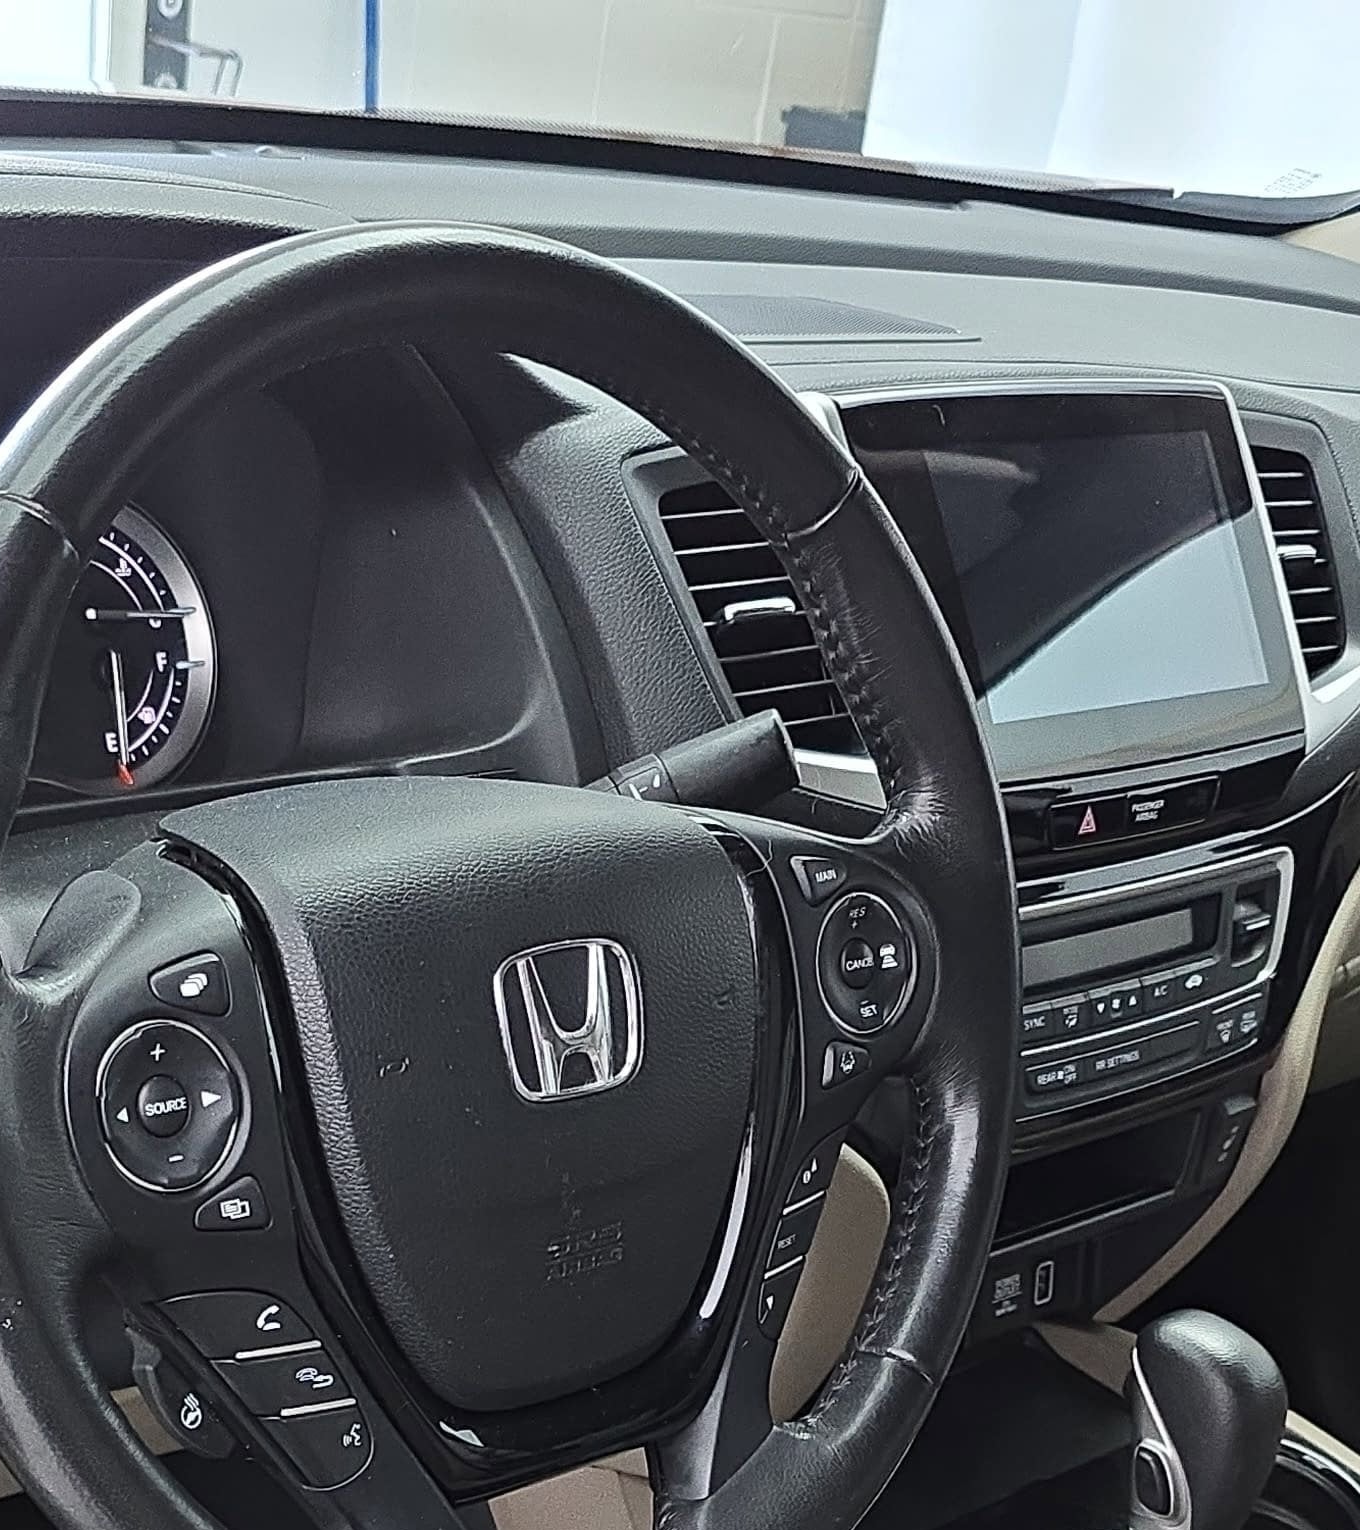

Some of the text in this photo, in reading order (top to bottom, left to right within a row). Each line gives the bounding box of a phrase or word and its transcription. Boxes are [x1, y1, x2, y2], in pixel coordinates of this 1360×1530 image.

[156, 651, 168, 673] F
[105, 732, 119, 753] E
[859, 1003, 878, 1018] SET
[144, 1096, 188, 1117] SOURCE
